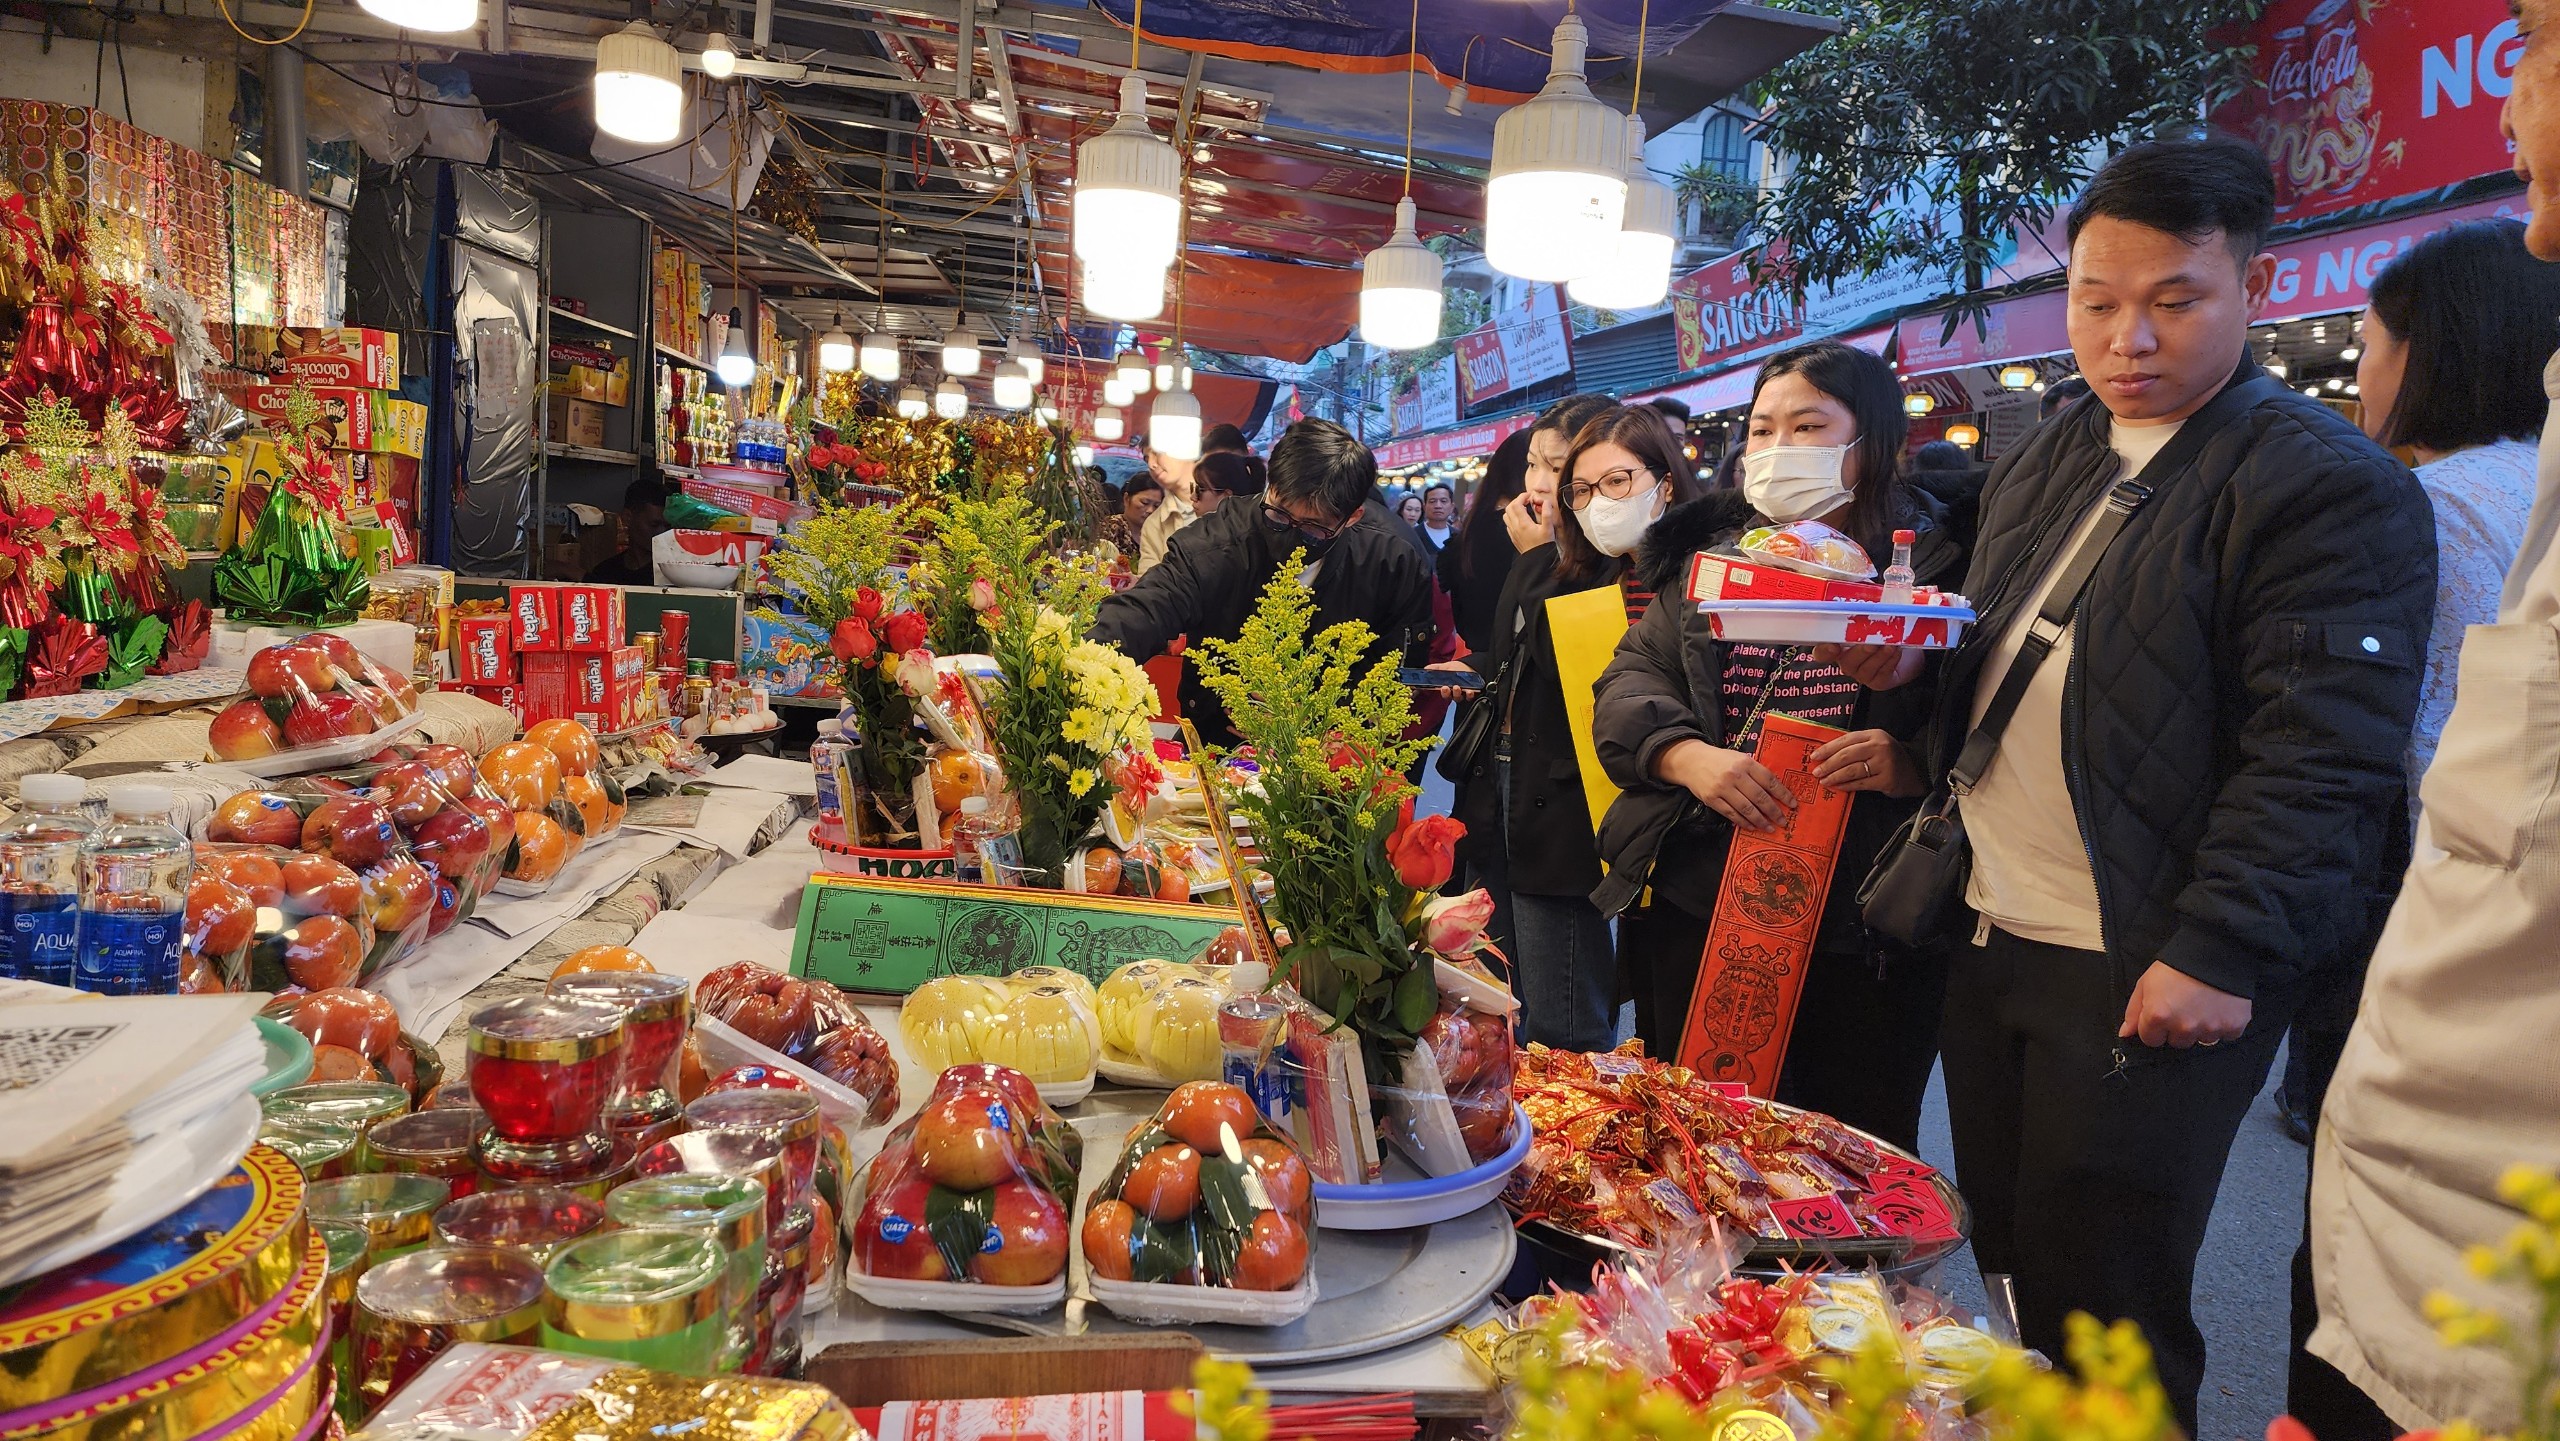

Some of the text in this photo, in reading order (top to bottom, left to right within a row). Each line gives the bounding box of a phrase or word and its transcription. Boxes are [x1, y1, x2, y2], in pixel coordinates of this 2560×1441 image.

[2422, 18, 2526, 119] NG
[1702, 285, 1800, 353] SAIGON
[291, 361, 350, 380] ChocoPie
[1469, 347, 1506, 390] SAIGON
[214, 465, 232, 508] Cust
[521, 593, 541, 643] PepPie
[571, 593, 591, 643] PepPie
[477, 628, 499, 679] PepPie
[1784, 669, 1800, 680] the
[586, 656, 605, 704] PepPie
[1774, 685, 1799, 698] both
[1787, 704, 1841, 718] represent
[34, 933, 75, 952] AQUA
[886, 1223, 910, 1232] JAZZ
